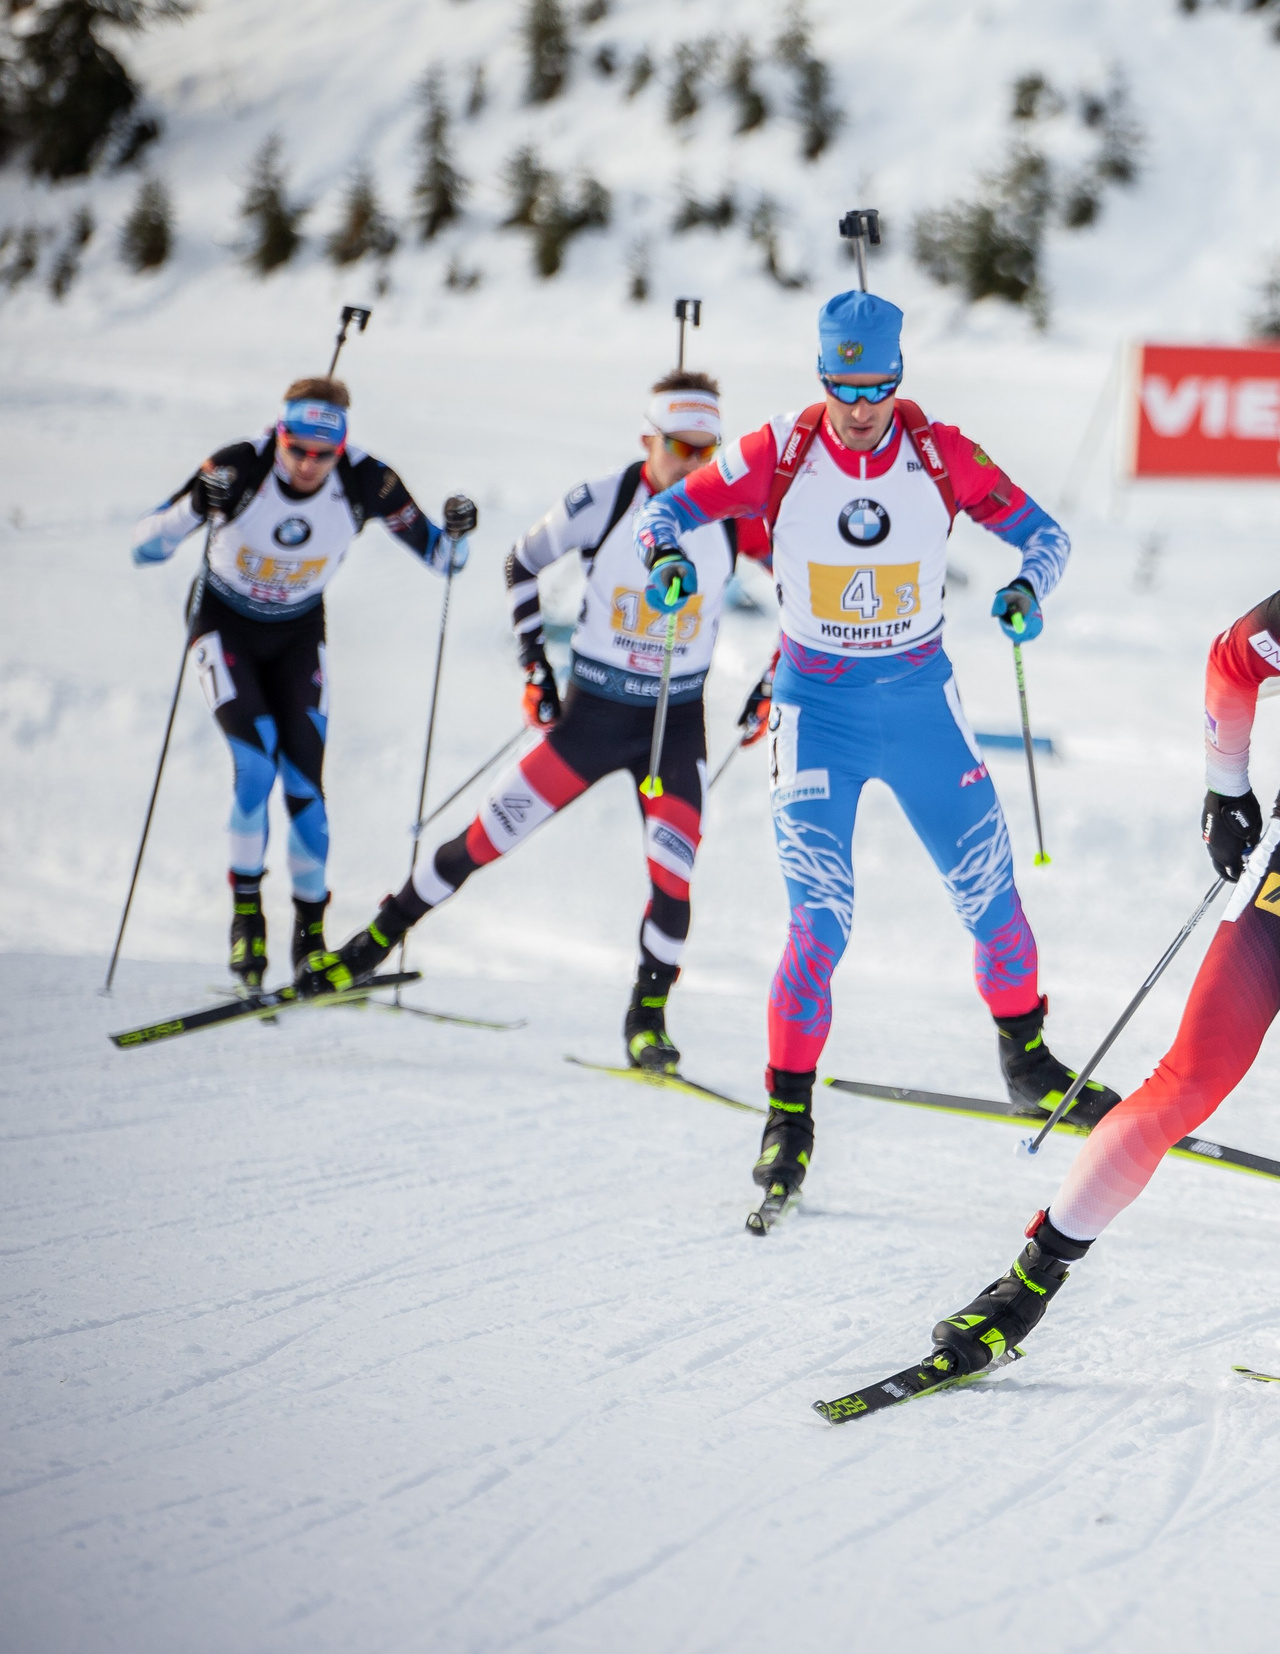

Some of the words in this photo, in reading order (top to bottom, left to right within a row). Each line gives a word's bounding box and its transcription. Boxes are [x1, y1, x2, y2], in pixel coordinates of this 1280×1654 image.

[782, 432, 802, 466] swix
[920, 437, 943, 470] swix
[840, 568, 882, 621] 4
[895, 583, 914, 616] 3
[821, 619, 912, 641] HOCHFILZEN
